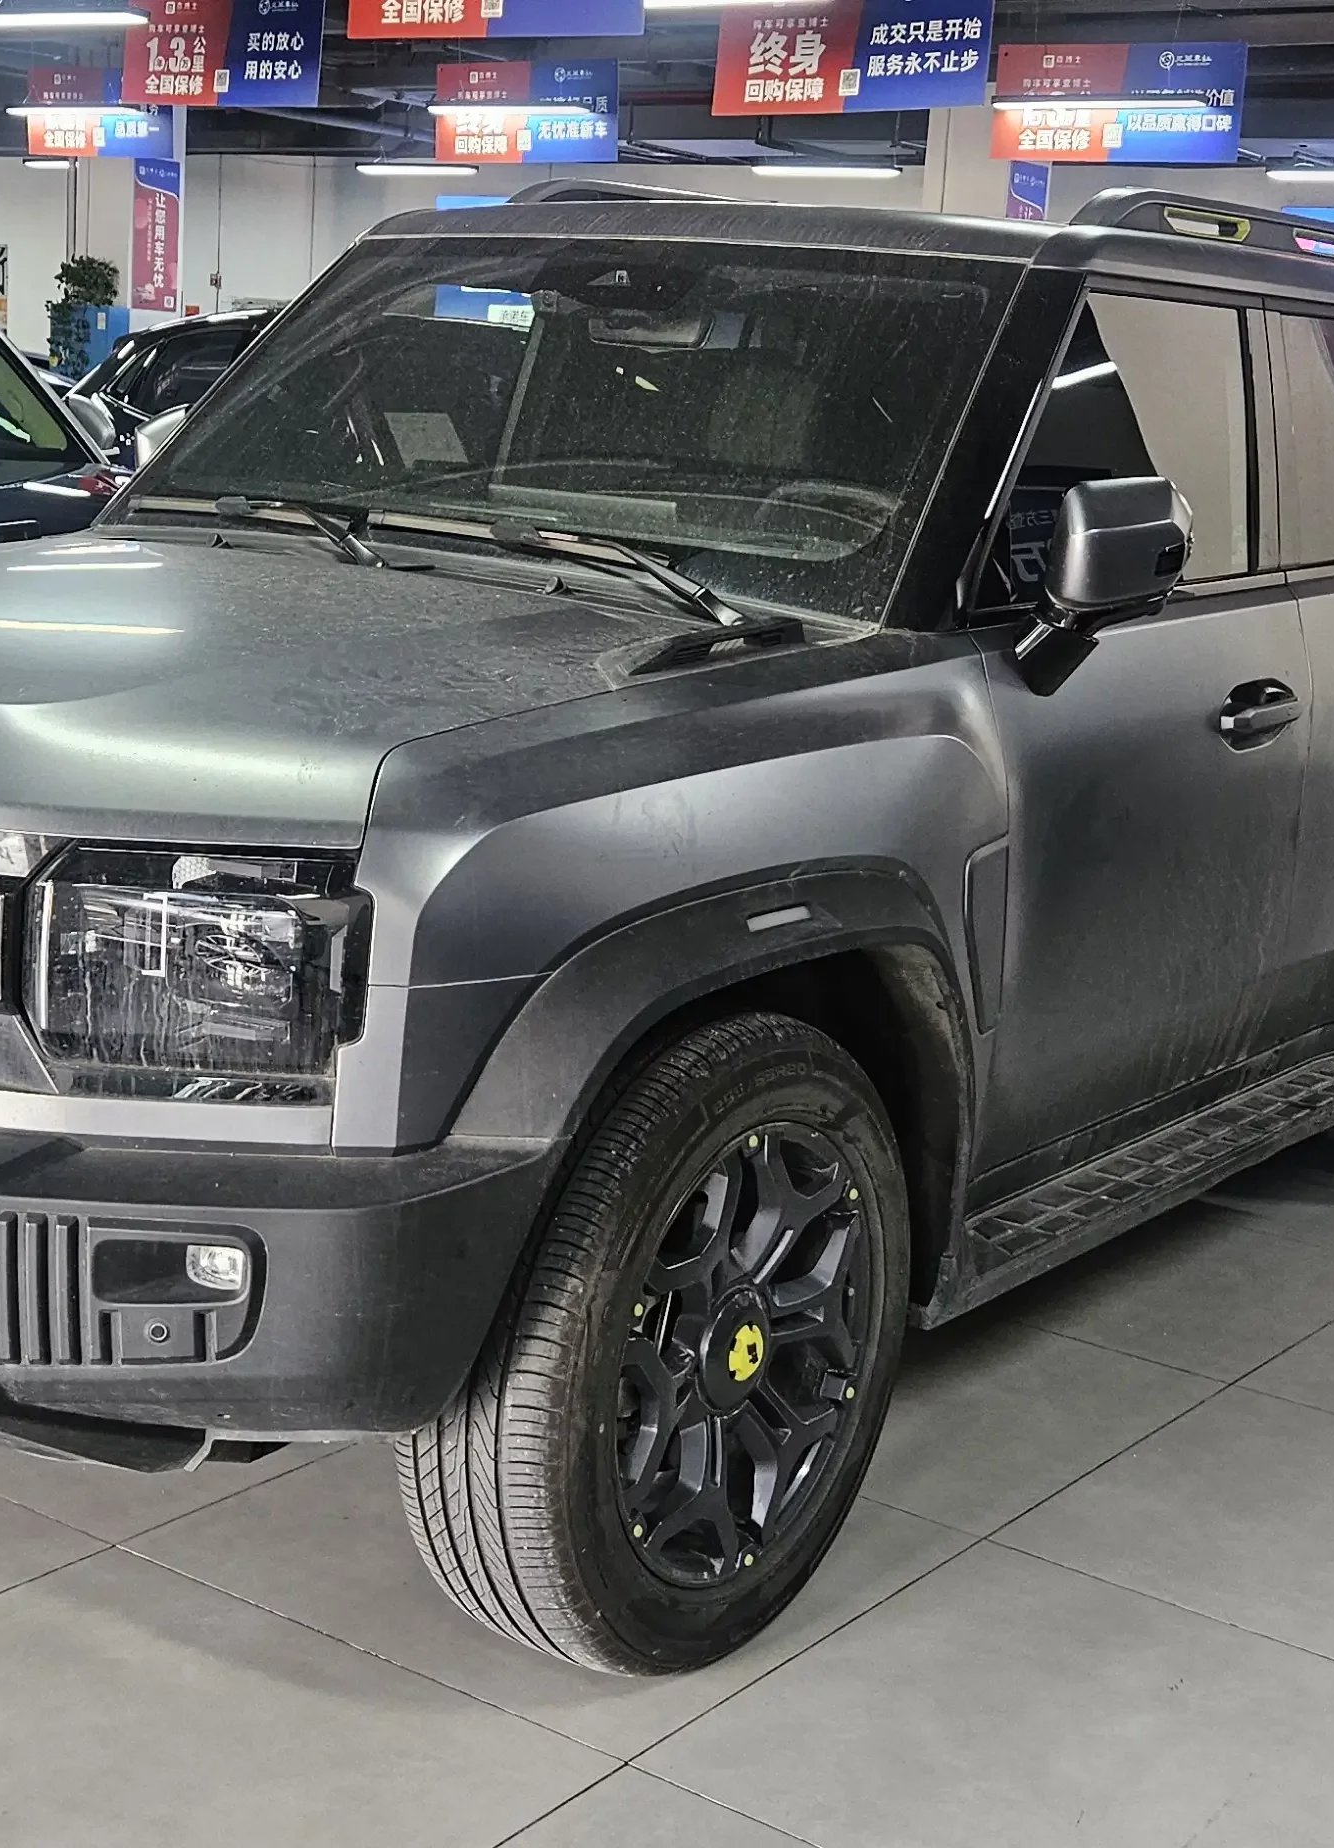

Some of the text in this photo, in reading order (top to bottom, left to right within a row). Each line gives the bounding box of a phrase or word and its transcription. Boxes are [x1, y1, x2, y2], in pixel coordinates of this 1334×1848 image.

[380, 0, 465, 25] 全国保修
[247, 31, 305, 52] 买的放心
[869, 16, 983, 46] 成交只是开始
[747, 30, 827, 77] 终身
[866, 49, 980, 78] 服务永不止步
[244, 59, 303, 81] 用的安心
[144, 73, 204, 96] 全国保修
[743, 77, 825, 104] 回购保障
[1017, 127, 1092, 151] 全国保修
